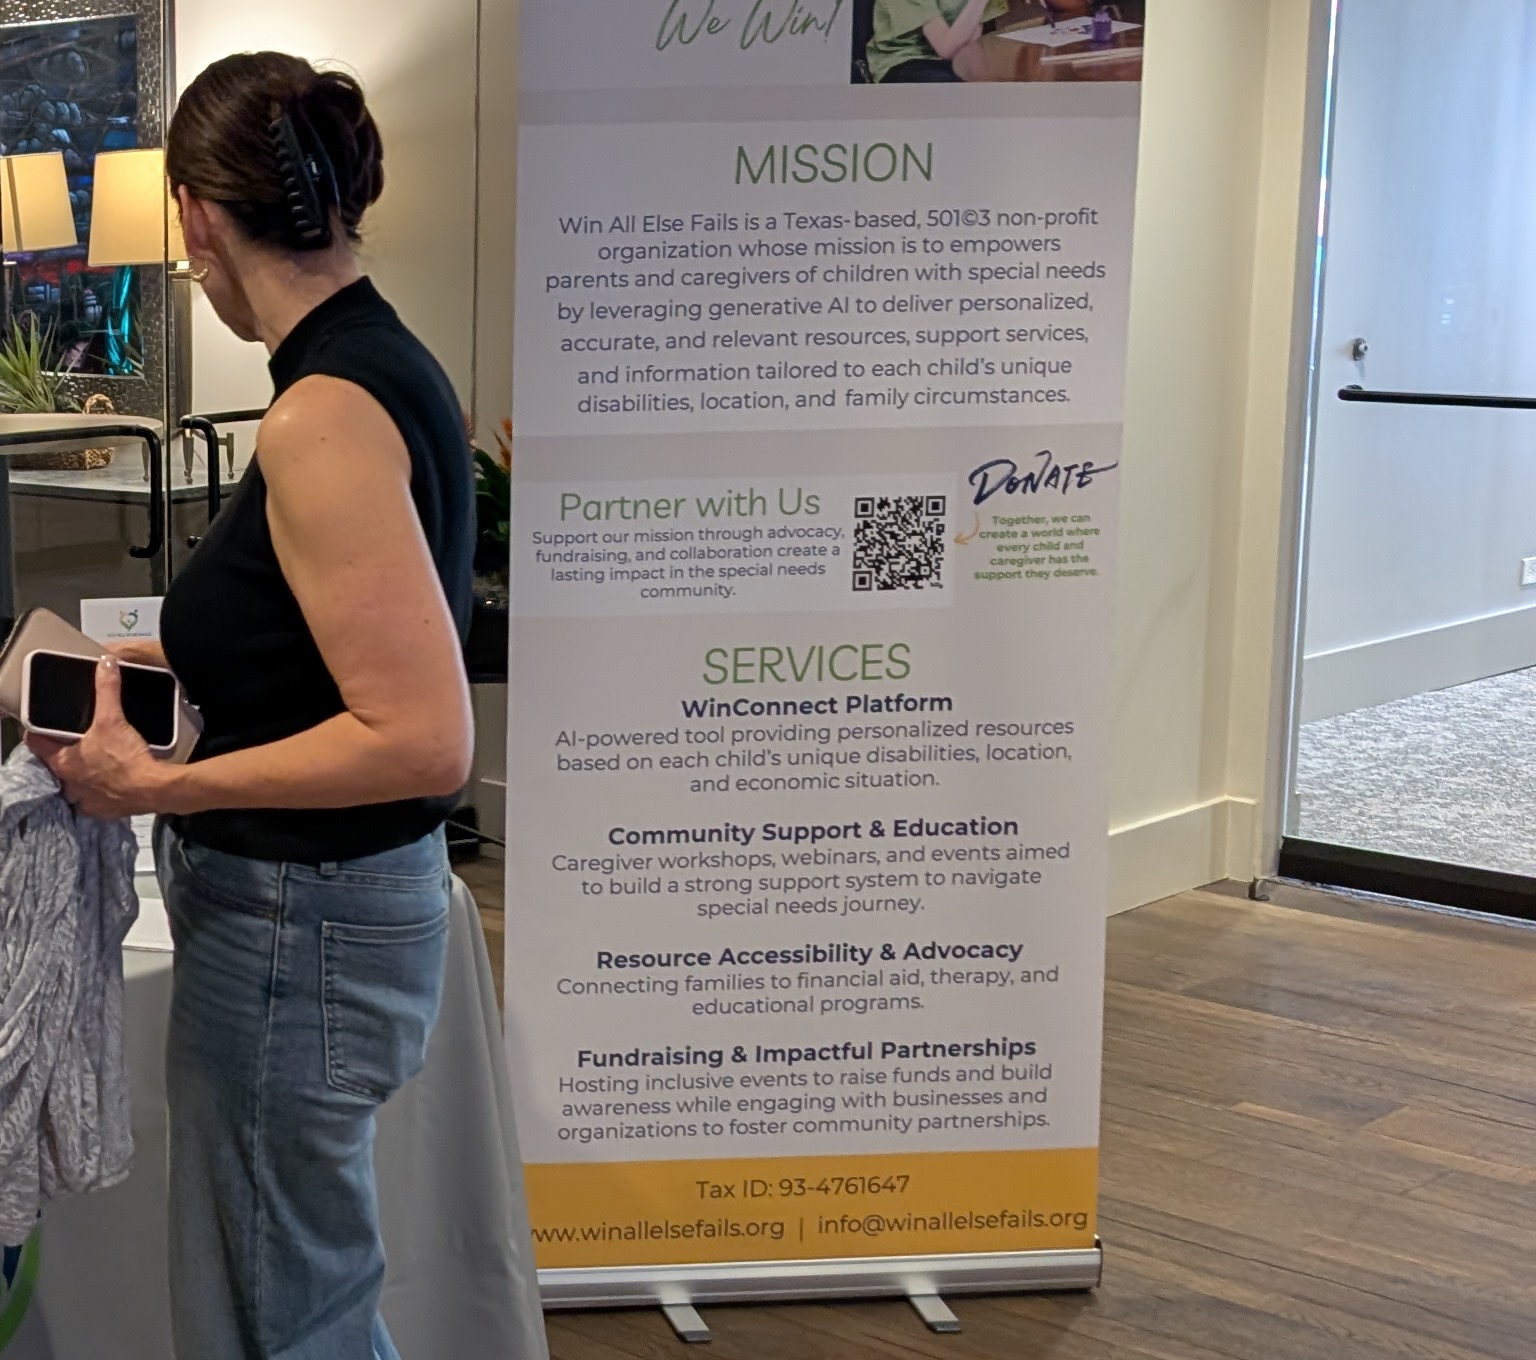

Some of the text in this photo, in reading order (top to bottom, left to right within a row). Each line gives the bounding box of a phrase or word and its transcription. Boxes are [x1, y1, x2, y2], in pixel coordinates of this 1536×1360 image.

[735, 142, 932, 184] MISSION
[558, 215, 602, 233] Win
[608, 214, 635, 233] All
[643, 213, 684, 232] Else
[691, 212, 738, 231] Fails
[744, 212, 759, 230] is
[765, 216, 776, 230] a
[997, 206, 1098, 229] non-profit
[598, 235, 1061, 264] organization whose mission is to empowers
[545, 260, 1105, 293] parents and caregivers of children with special needs
[577, 386, 1070, 413] disabilities, location, and family circumstances.
[560, 487, 820, 521] Partner with Us
[979, 526, 1100, 539] create a world where
[991, 514, 1090, 527] Together, we can
[532, 524, 845, 547] Support our mission through advocacy,
[996, 539, 1084, 553] every child and
[535, 544, 840, 565] fundraising, and collaboration create a
[989, 553, 1089, 567] caregiver has the
[550, 560, 825, 584] lasting impact in the special needs
[973, 569, 1022, 581] support
[1024, 568, 1050, 580] they
[640, 582, 736, 599] community.
[702, 642, 910, 685] SERVICES
[681, 692, 952, 718] WinConnect Platform
[554, 719, 1074, 750] AI-powered tool providing personalized resources
[608, 815, 1017, 846] Community Support & Education
[551, 840, 1070, 875] Caregiver workshops, webinars, and events aimed
[597, 940, 1023, 969] Resource Accessibility & Advocacy
[556, 964, 1058, 996] Connecting families to financial aid, therapy, and
[692, 995, 924, 1015] educational programs.
[578, 1035, 1036, 1068] Fundraising & Impactful Partnerships
[559, 1062, 1052, 1095] Hosting inclusive events to raise funds and build
[695, 1174, 909, 1199] Tax ID: 93-4761647
[531, 1208, 1088, 1242] ww.winallelsefails.org info@winallelsefails.org
